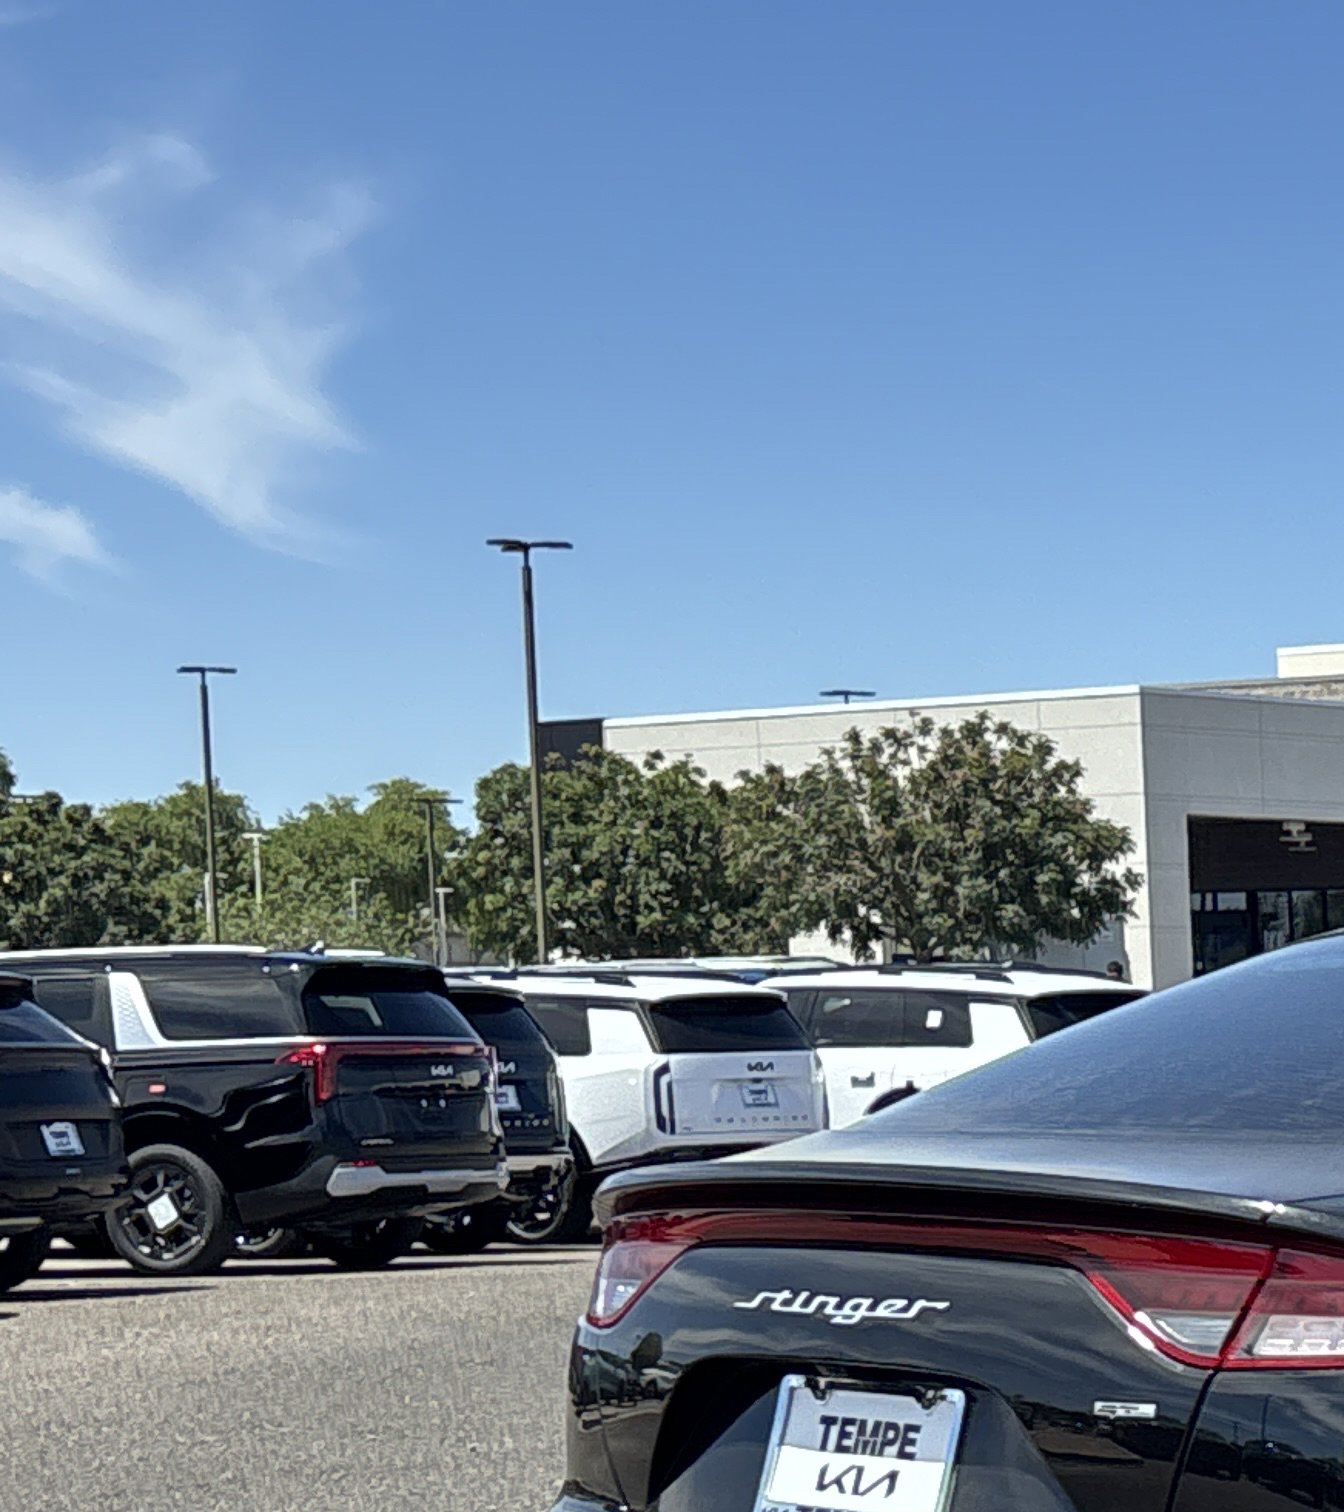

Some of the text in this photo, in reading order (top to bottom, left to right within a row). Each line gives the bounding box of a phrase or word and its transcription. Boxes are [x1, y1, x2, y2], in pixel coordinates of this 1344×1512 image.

[746, 1061, 775, 1072] KIA
[733, 1289, 950, 1325] stinger
[818, 1414, 922, 1461] TEMPE
[815, 1462, 901, 1499] KIA
